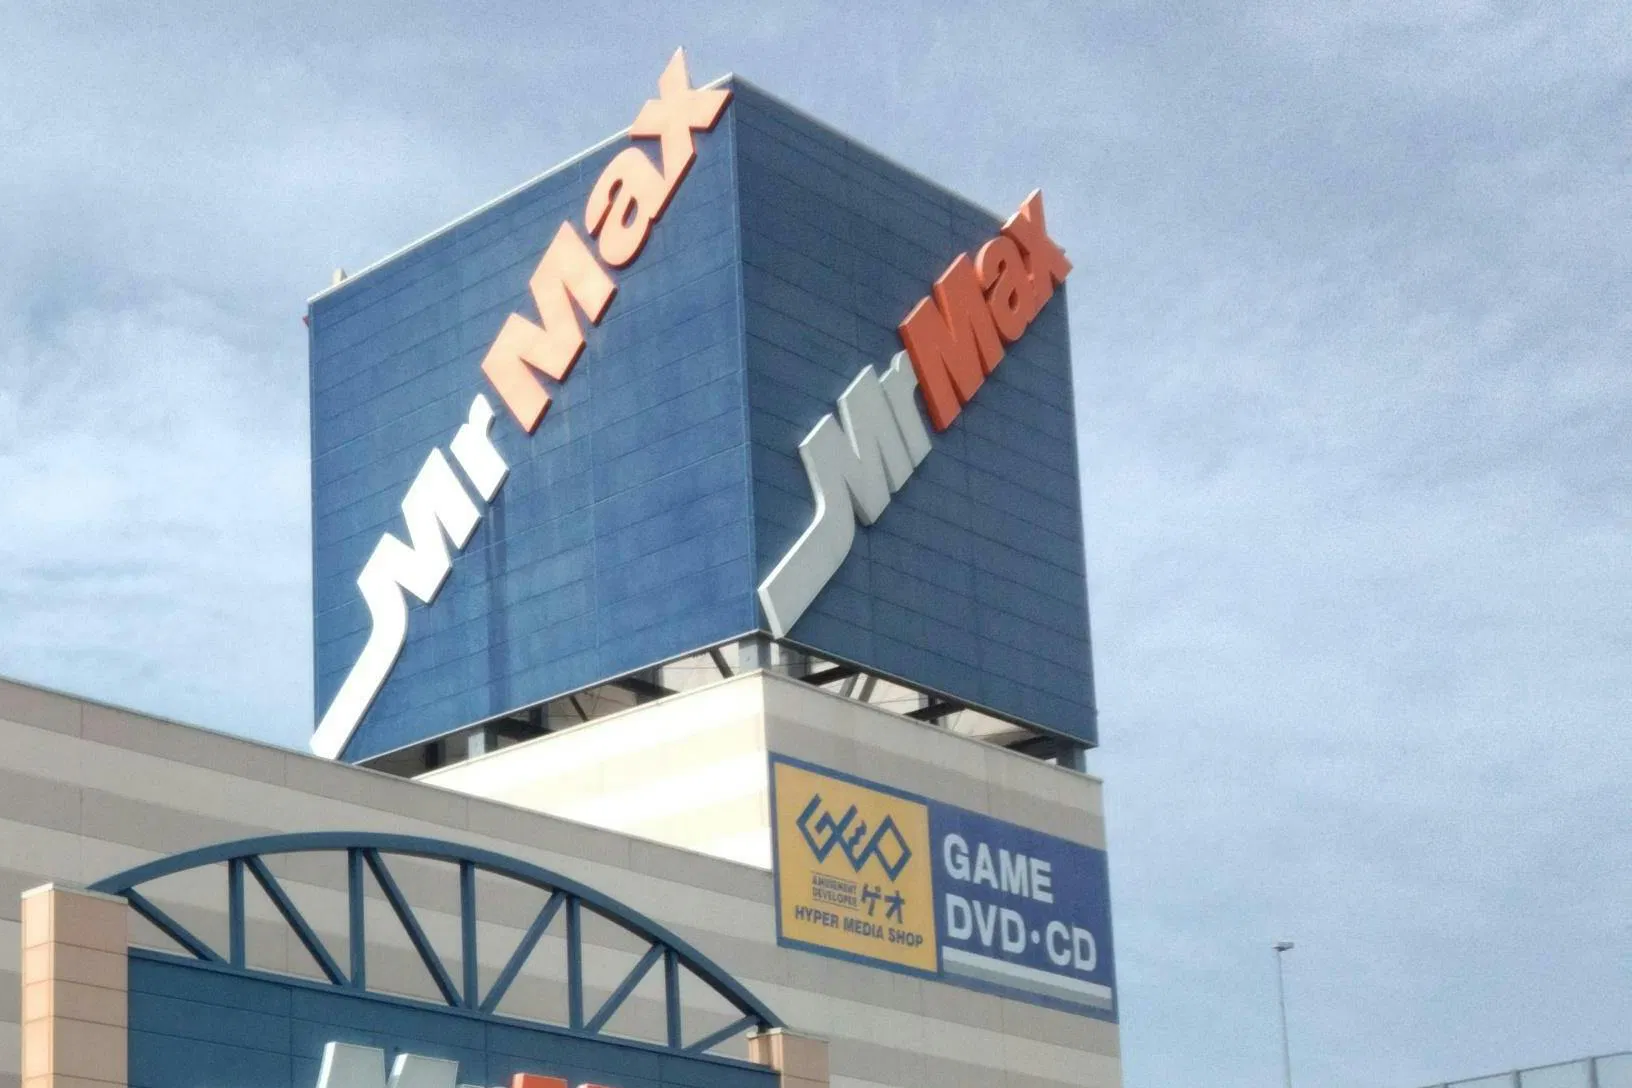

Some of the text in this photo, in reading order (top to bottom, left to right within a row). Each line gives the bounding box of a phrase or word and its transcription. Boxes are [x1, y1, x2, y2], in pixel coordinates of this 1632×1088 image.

[310, 47, 733, 760] MrMax
[758, 188, 1073, 638] MrMax
[812, 887, 857, 907] DEVELOPER
[943, 833, 1054, 904] GAME
[795, 905, 923, 948] HYPER MEDIA SHOP
[861, 883, 905, 924] ゲオ
